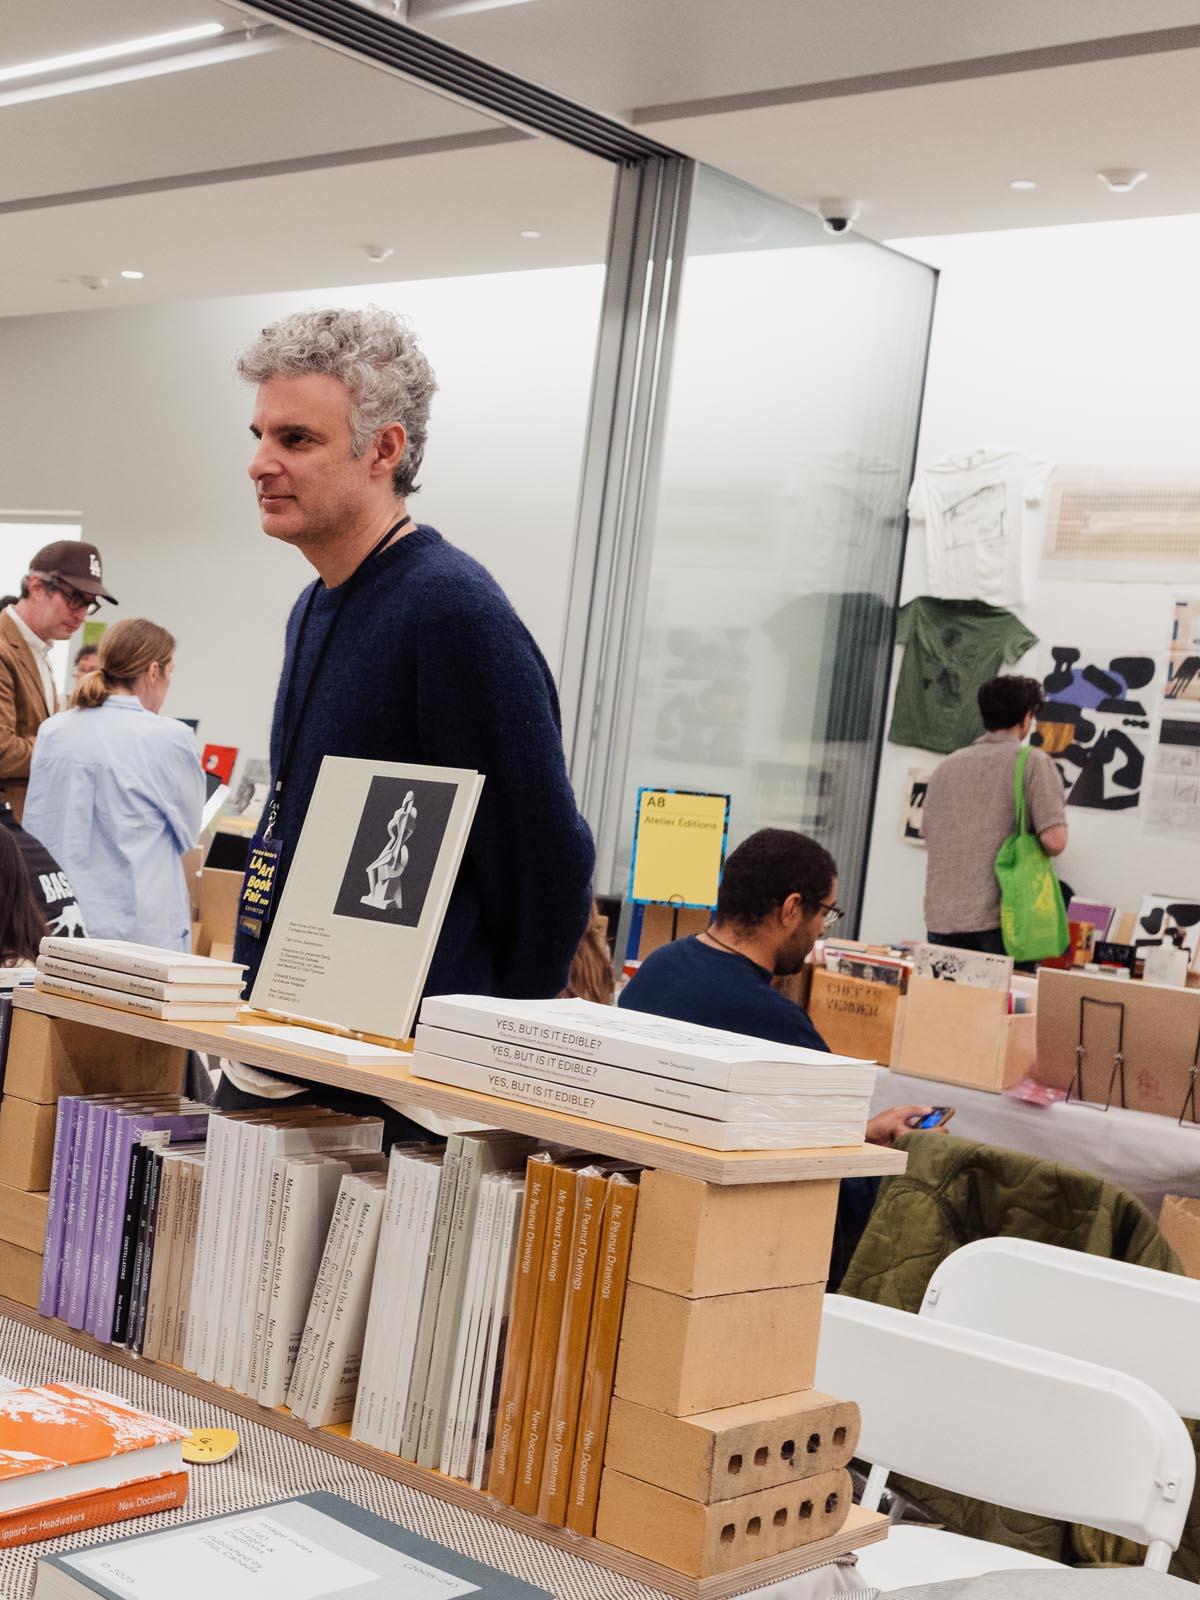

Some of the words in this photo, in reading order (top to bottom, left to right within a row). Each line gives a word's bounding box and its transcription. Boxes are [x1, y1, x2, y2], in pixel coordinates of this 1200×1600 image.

[644, 815, 675, 827] Atelier
[249, 856, 263, 870] LA
[257, 864, 275, 878] Art
[243, 889, 261, 903] Fair
[247, 875, 272, 892] Book
[496, 1019, 517, 1031] YES,
[519, 1024, 538, 1035] BUT
[541, 1029, 550, 1038] IS
[552, 1031, 560, 1040] IT
[562, 1033, 601, 1050] EDIBLE?
[491, 1045, 512, 1058] YES,
[514, 1051, 534, 1062] BUT
[536, 1056, 545, 1064] IS
[547, 1058, 556, 1066] IT
[558, 1060, 597, 1076] EDIBLE?
[488, 1075, 510, 1087] YES,
[511, 1080, 531, 1092] BUT
[533, 1086, 542, 1095] IS
[545, 1089, 553, 1097] IT
[555, 1091, 595, 1108] EDIBLE?
[55, 1111, 64, 1143] Lippard
[532, 1182, 540, 1196] Mr.
[268, 1199, 276, 1225] Fusco
[336, 1191, 346, 1215] Maria
[527, 1198, 538, 1229] Peanut
[584, 1197, 592, 1211] Mr.
[613, 1204, 621, 1218] Mr.
[281, 1205, 289, 1232] Fusco
[329, 1217, 340, 1243] Fusco
[554, 1205, 564, 1237] Peanut
[580, 1213, 591, 1245] Peanut
[608, 1220, 619, 1253] Peanut
[522, 1231, 534, 1274] Drawings
[547, 1238, 561, 1282] Drawings
[41, 1256, 49, 1302] Documents
[262, 1261, 268, 1274] Up
[275, 1268, 281, 1280] Up
[320, 1256, 330, 1276] Give
[573, 1247, 587, 1290] Drawings
[602, 1254, 615, 1299] Drawings
[316, 1277, 324, 1291] Up
[313, 1292, 321, 1306] Art
[303, 1325, 312, 1344] New
[250, 1333, 261, 1383] Documents
[262, 1340, 273, 1390] Documents
[291, 1345, 307, 1394] Documents
[505, 1400, 513, 1421] New
[531, 1410, 540, 1431] New
[555, 1420, 565, 1442] New
[583, 1429, 593, 1451] New
[498, 1423, 510, 1475] Documents
[524, 1432, 537, 1484] Documents
[549, 1443, 562, 1496] Documents
[576, 1452, 590, 1506] Documents
[118, 1500, 135, 1510] New
[136, 1490, 177, 1506] Documents
[39, 1512, 86, 1529] Headwaters
